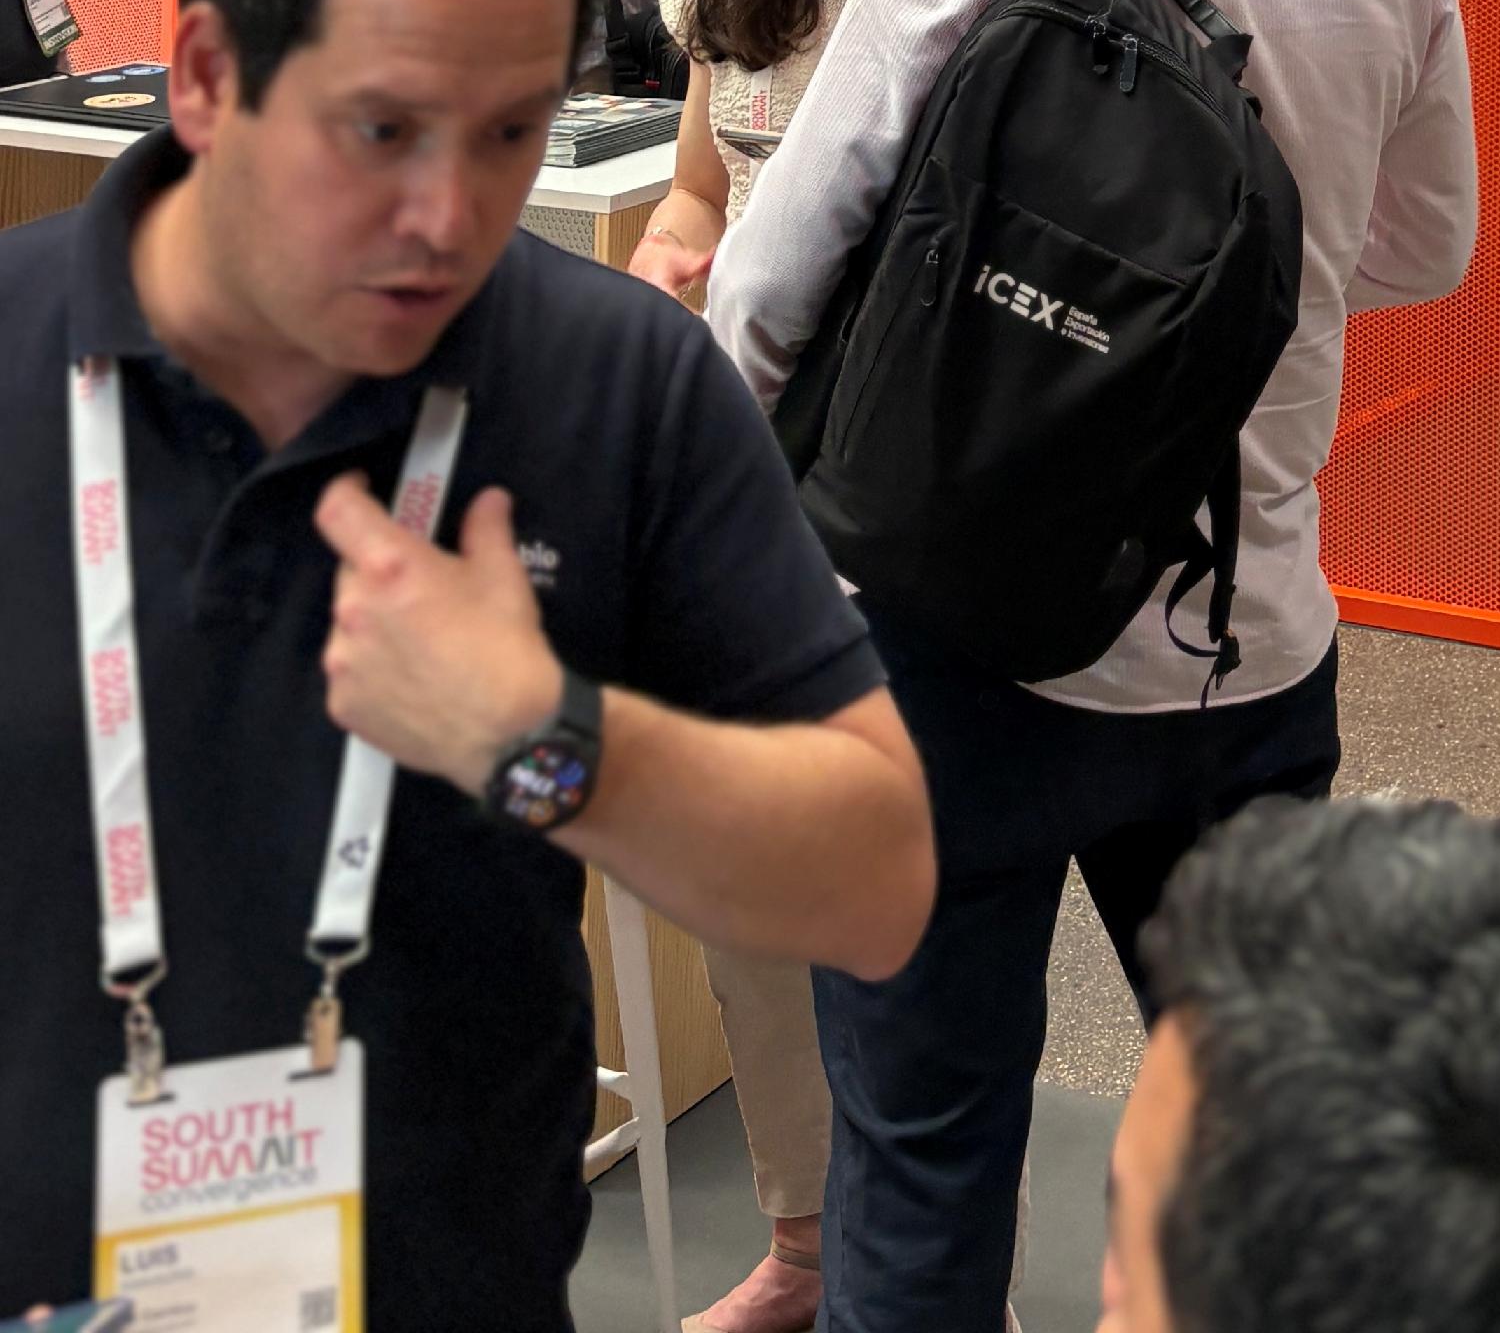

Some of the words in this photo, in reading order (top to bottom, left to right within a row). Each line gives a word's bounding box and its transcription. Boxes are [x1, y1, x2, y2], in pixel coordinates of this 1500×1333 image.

[142, 1096, 295, 1155] SOUTH
[141, 1127, 324, 1193] SUMMIT
[140, 1167, 318, 1213] convergence
[119, 1242, 179, 1275] LUIS
